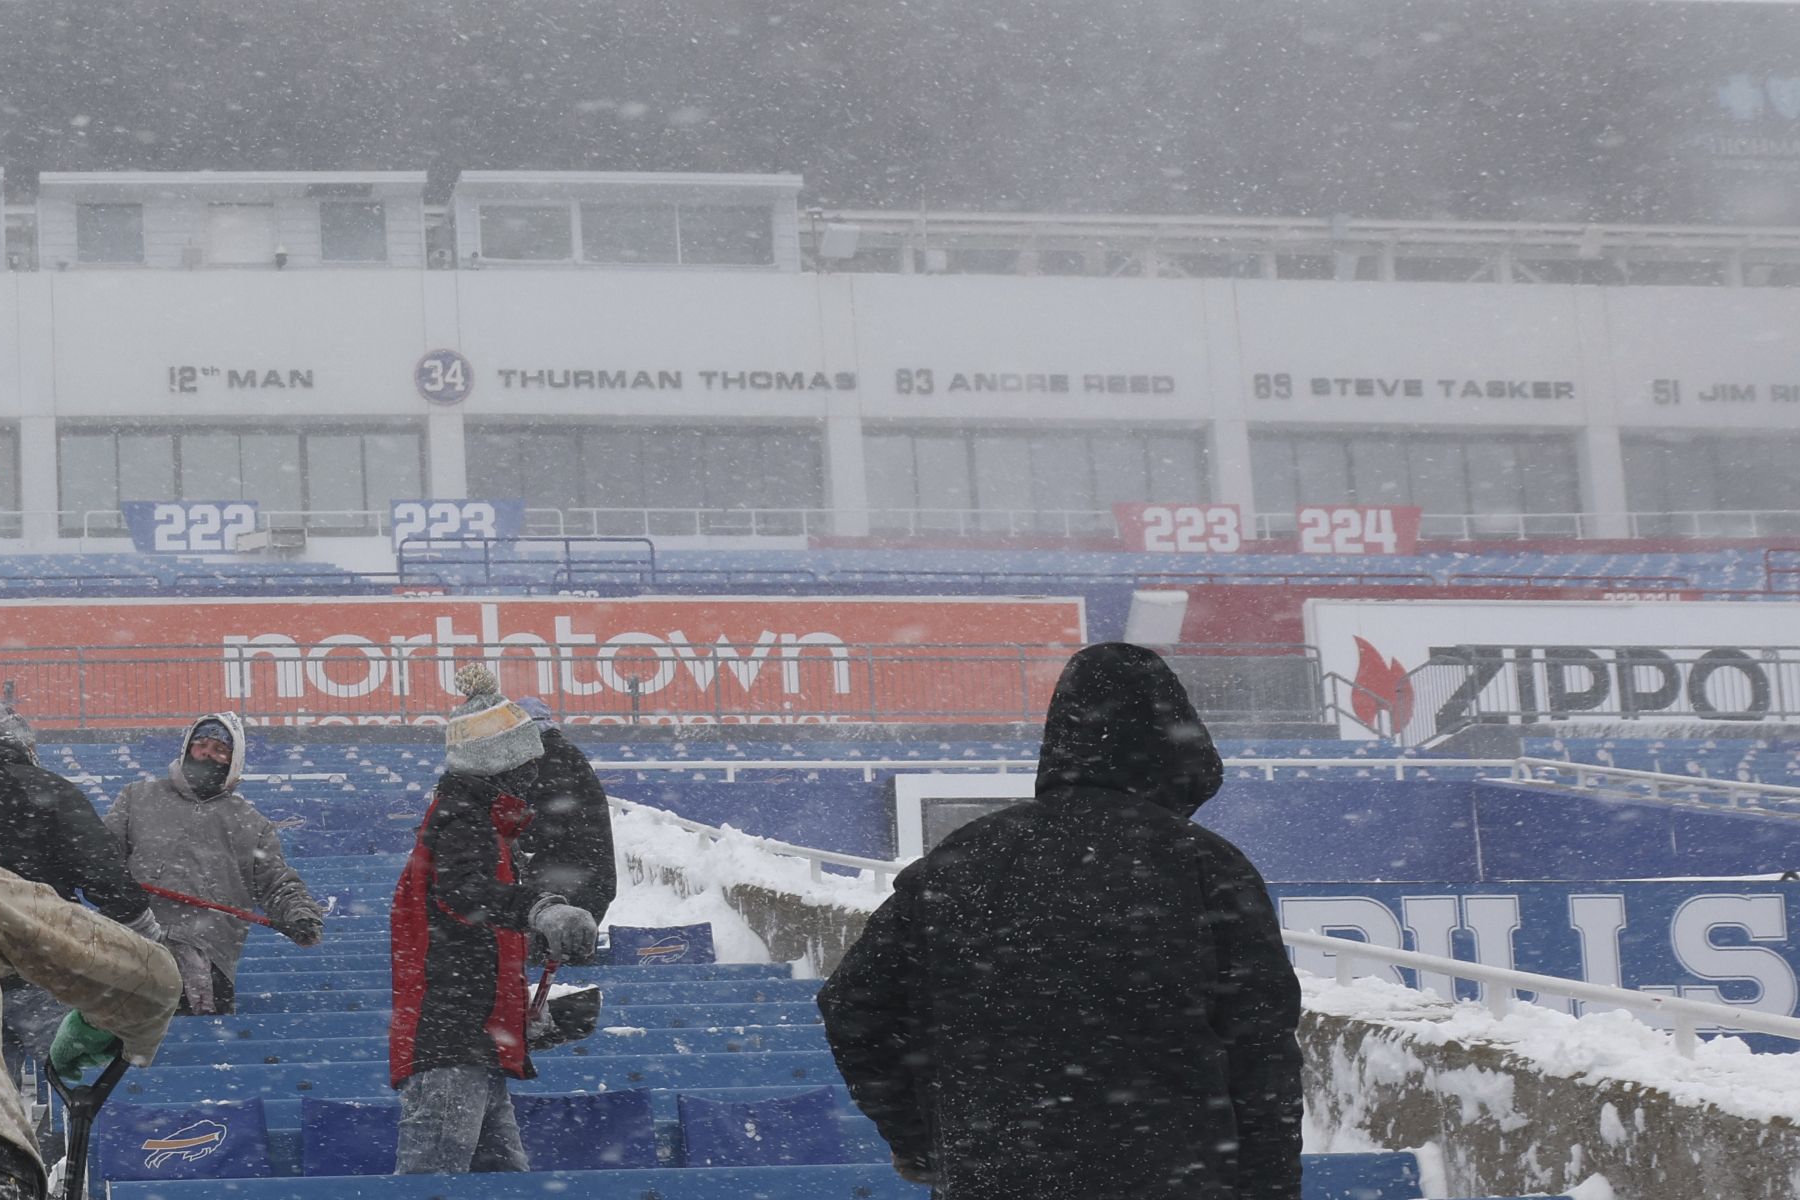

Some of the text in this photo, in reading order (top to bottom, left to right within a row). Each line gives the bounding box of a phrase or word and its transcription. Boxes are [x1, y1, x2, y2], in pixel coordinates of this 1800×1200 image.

[227, 368, 313, 390] MAN
[423, 360, 857, 391] 34 THURMAN THOMAS
[948, 372, 1070, 393] ANDRE
[1084, 374, 1174, 395] REED
[1311, 376, 1424, 397] STEVE
[1437, 379, 1575, 400] TASKER
[1652, 379, 1680, 405] 51
[1699, 384, 1757, 403] JIM
[154, 504, 256, 551] 222
[394, 502, 497, 549] 223
[1142, 507, 1241, 554] 223
[1299, 508, 1398, 554] 224
[222, 603, 851, 697] northtown
[1427, 645, 1771, 732] ZIPPO
[1279, 894, 1800, 1036] BILLS
